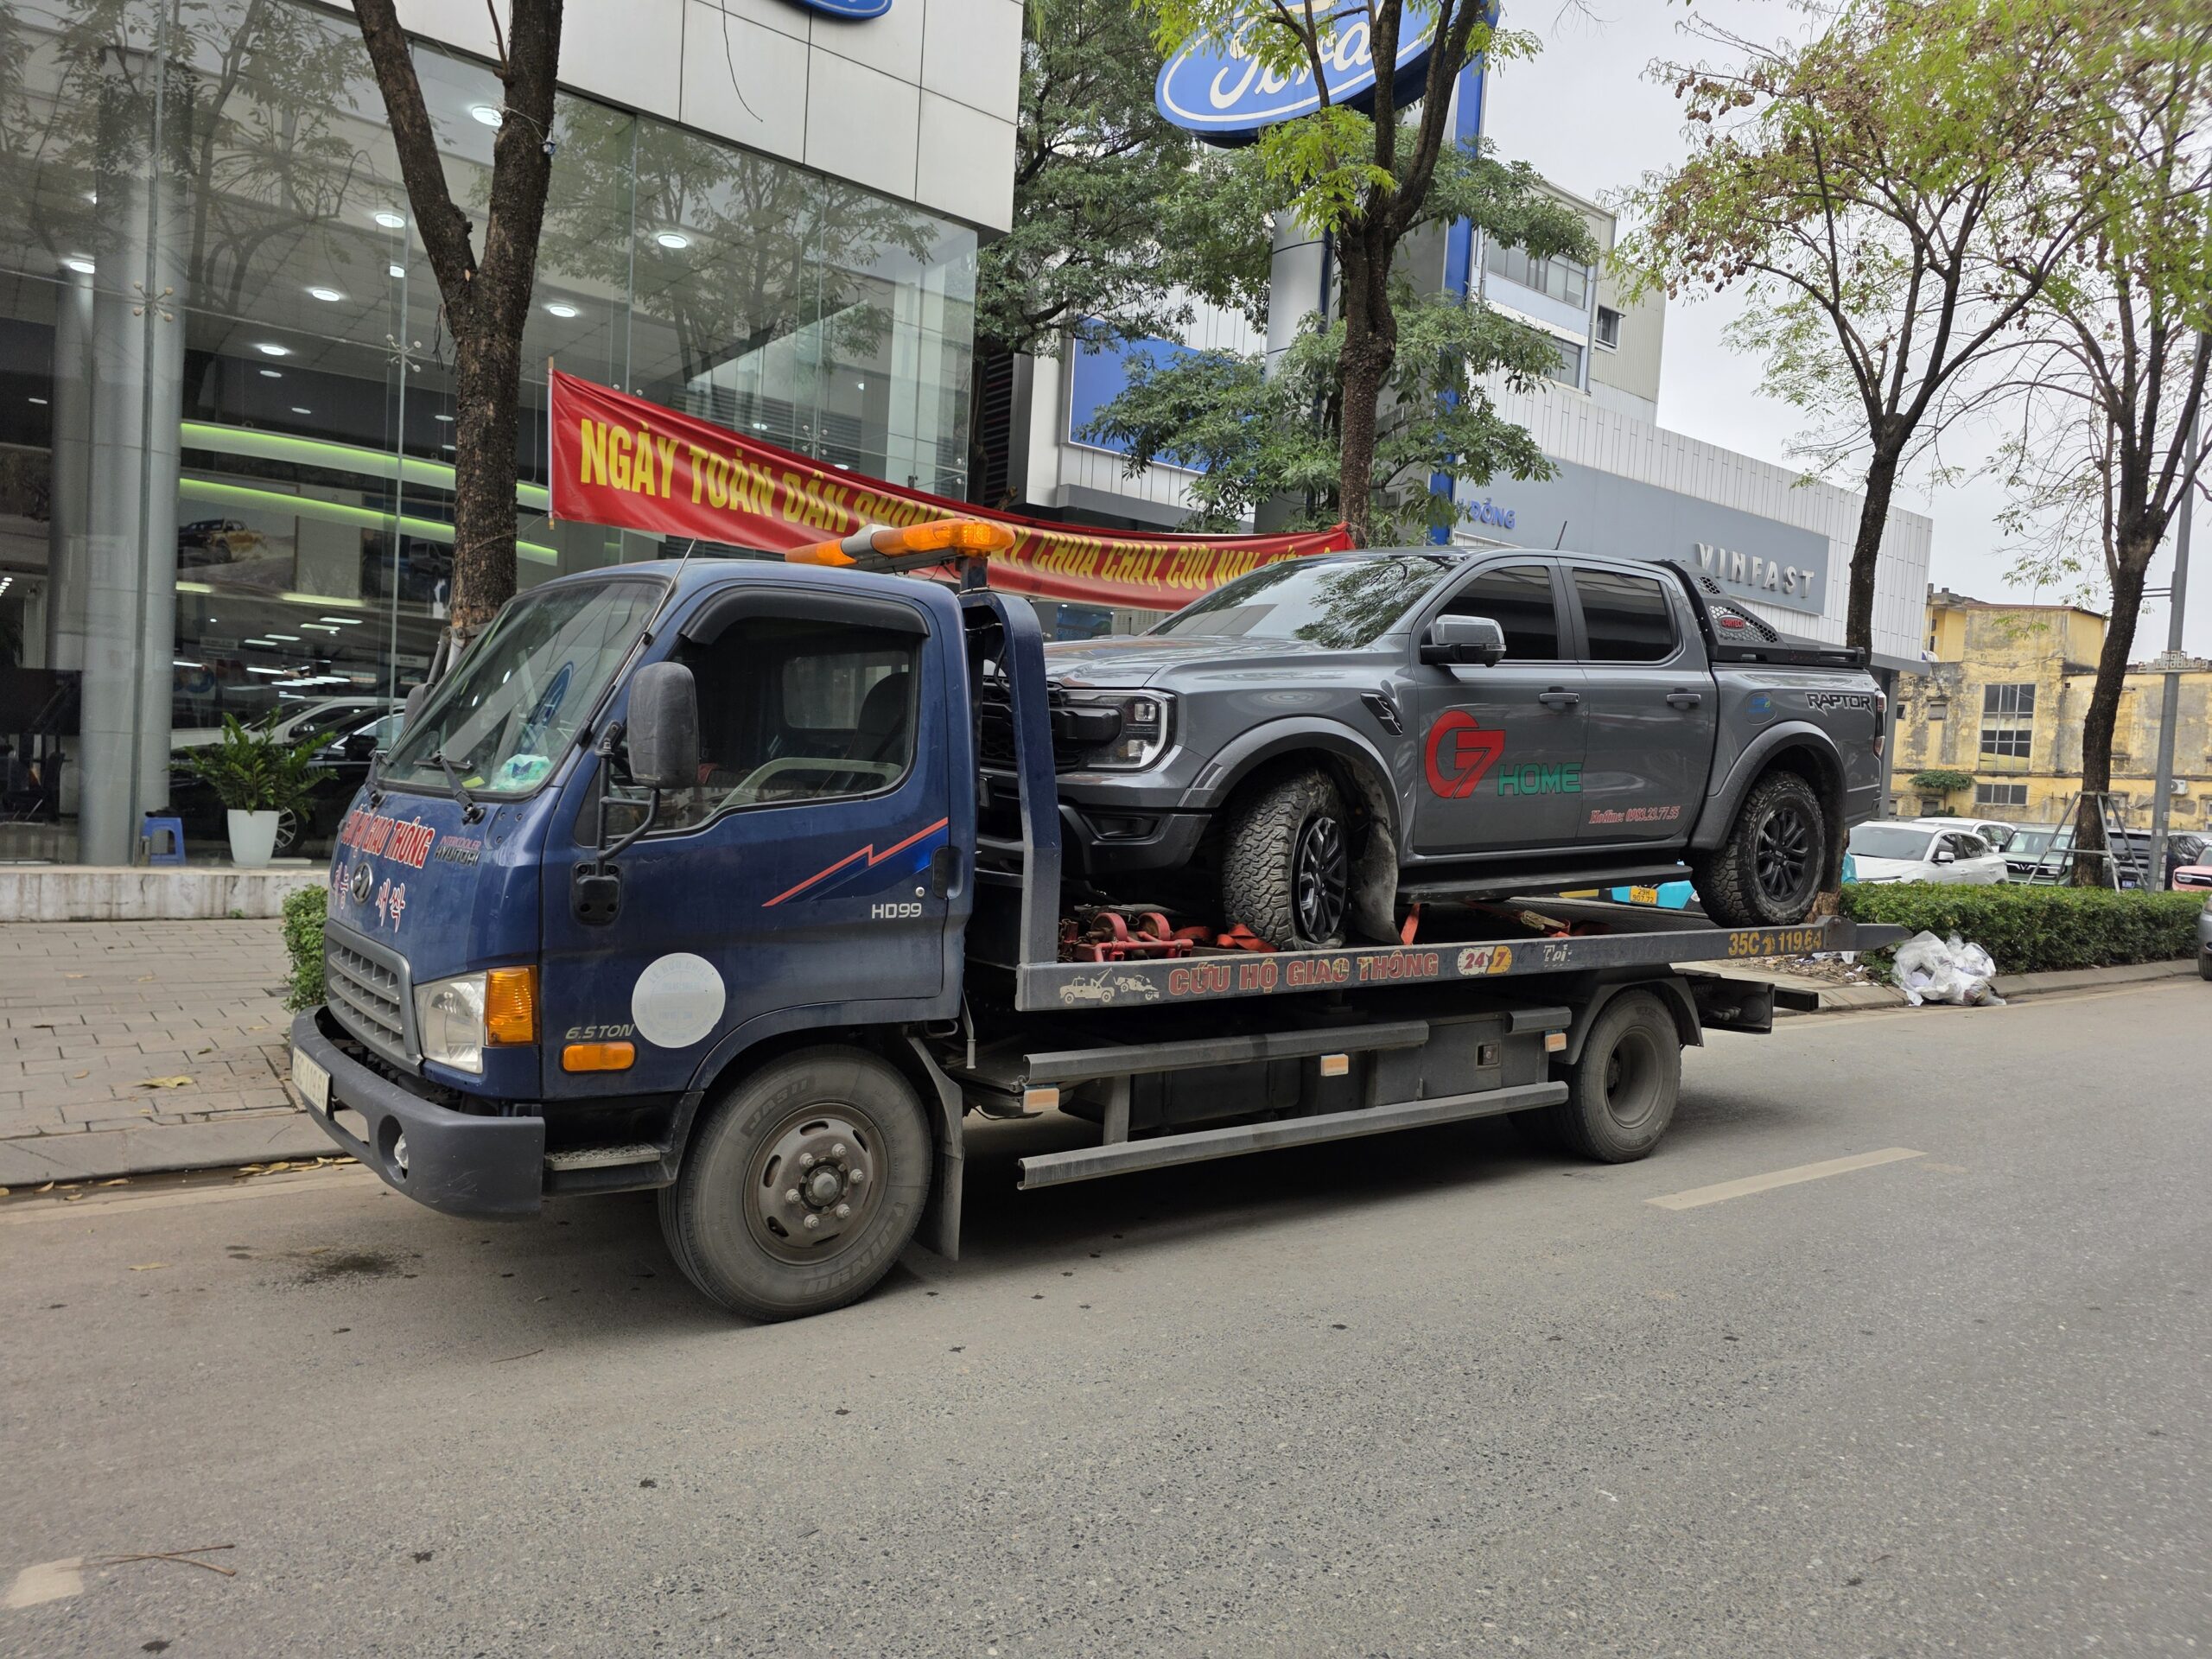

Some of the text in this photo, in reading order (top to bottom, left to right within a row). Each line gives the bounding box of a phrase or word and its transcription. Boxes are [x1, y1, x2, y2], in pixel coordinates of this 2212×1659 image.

[581, 418, 679, 499] NGÀY
[689, 444, 774, 518] TOÀN
[783, 470, 849, 532] DÂN
[1694, 542, 1815, 598] VINFAST
[1805, 692, 1875, 717] RAPTOR
[1424, 709, 1584, 799] G7 HOME
[385, 816, 435, 869] THÔNG
[871, 902, 922, 919] HD99
[1168, 962, 1230, 995] CỨU
[1239, 957, 1278, 994] HỘ
[1286, 957, 1351, 987] GIAO
[1357, 950, 1440, 982] THÔNG
